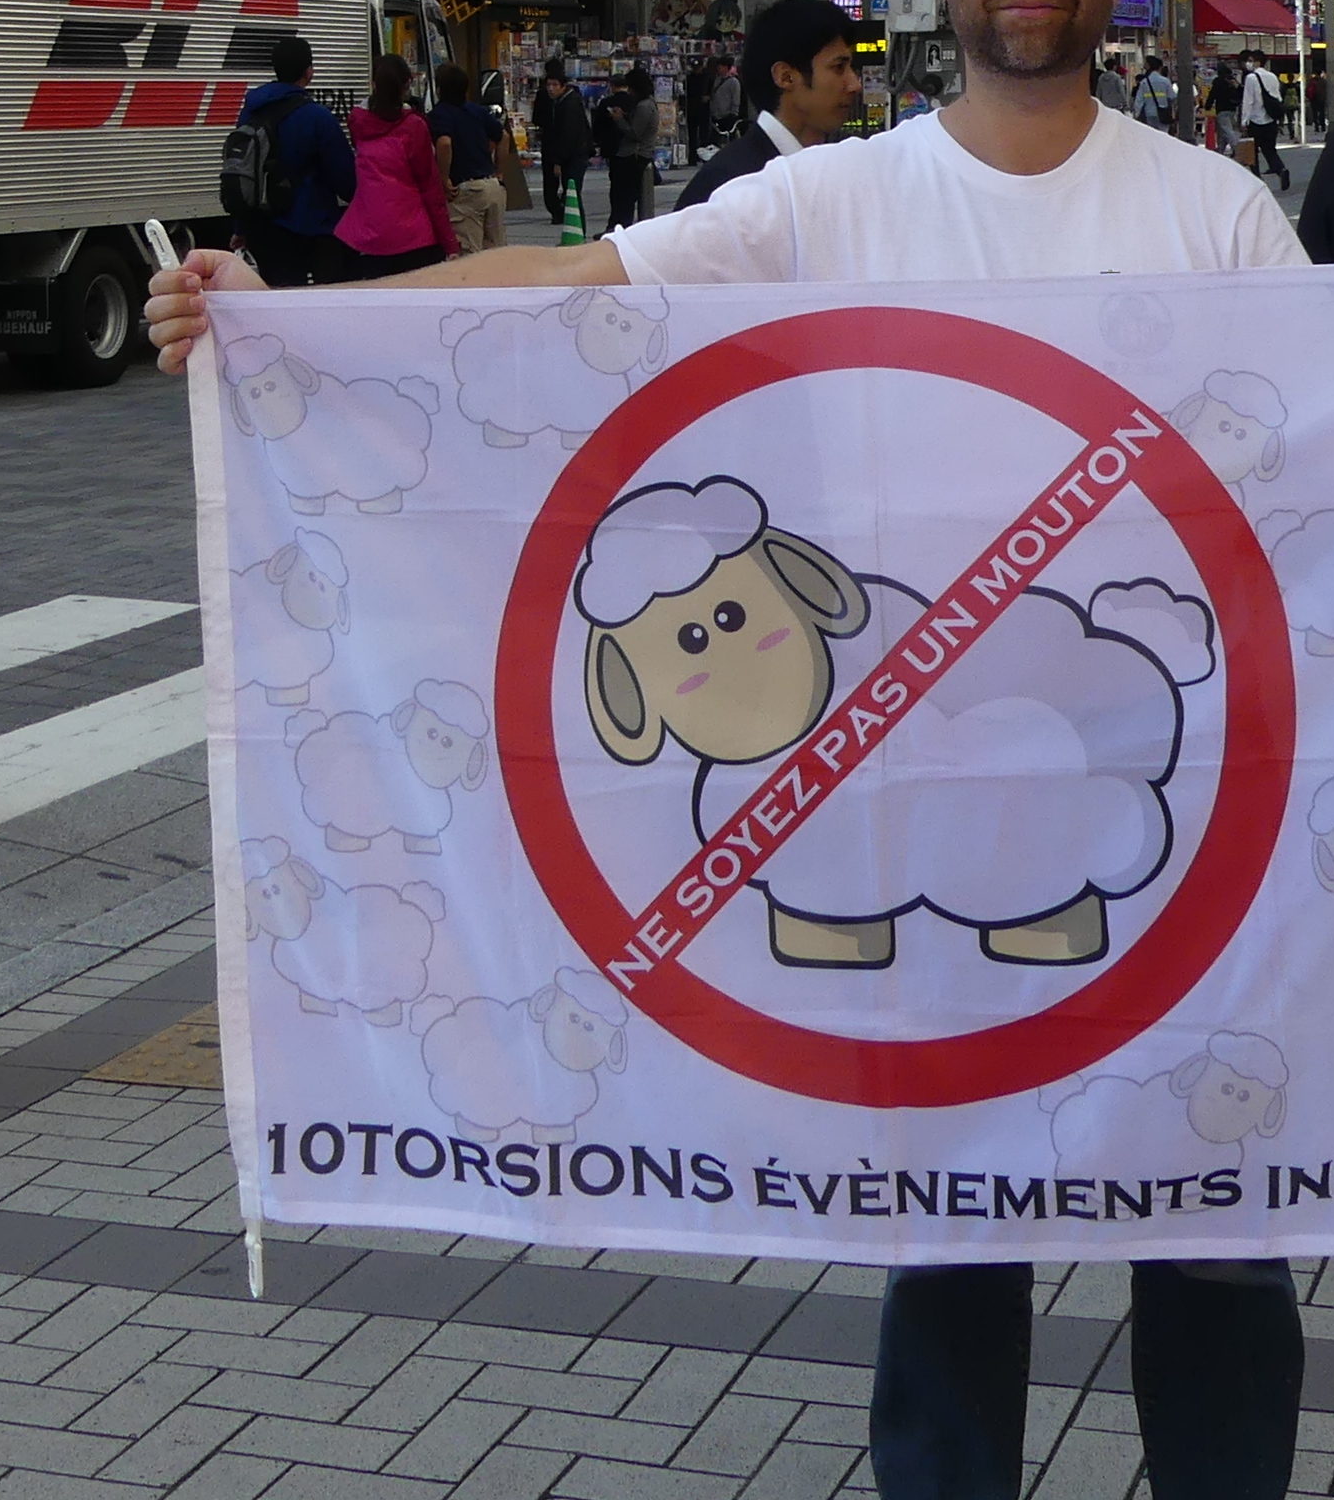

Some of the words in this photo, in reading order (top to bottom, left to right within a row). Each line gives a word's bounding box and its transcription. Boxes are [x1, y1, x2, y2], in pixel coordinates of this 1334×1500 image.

[607, 911, 683, 991] NE
[677, 766, 821, 919] SOYEZ
[812, 672, 909, 772] PAS
[901, 598, 973, 674] UN
[970, 408, 1164, 606] MOUTON
[268, 1121, 734, 1203] 10TORSIONS
[754, 1157, 1243, 1222] ÉVÈNEMENTS
